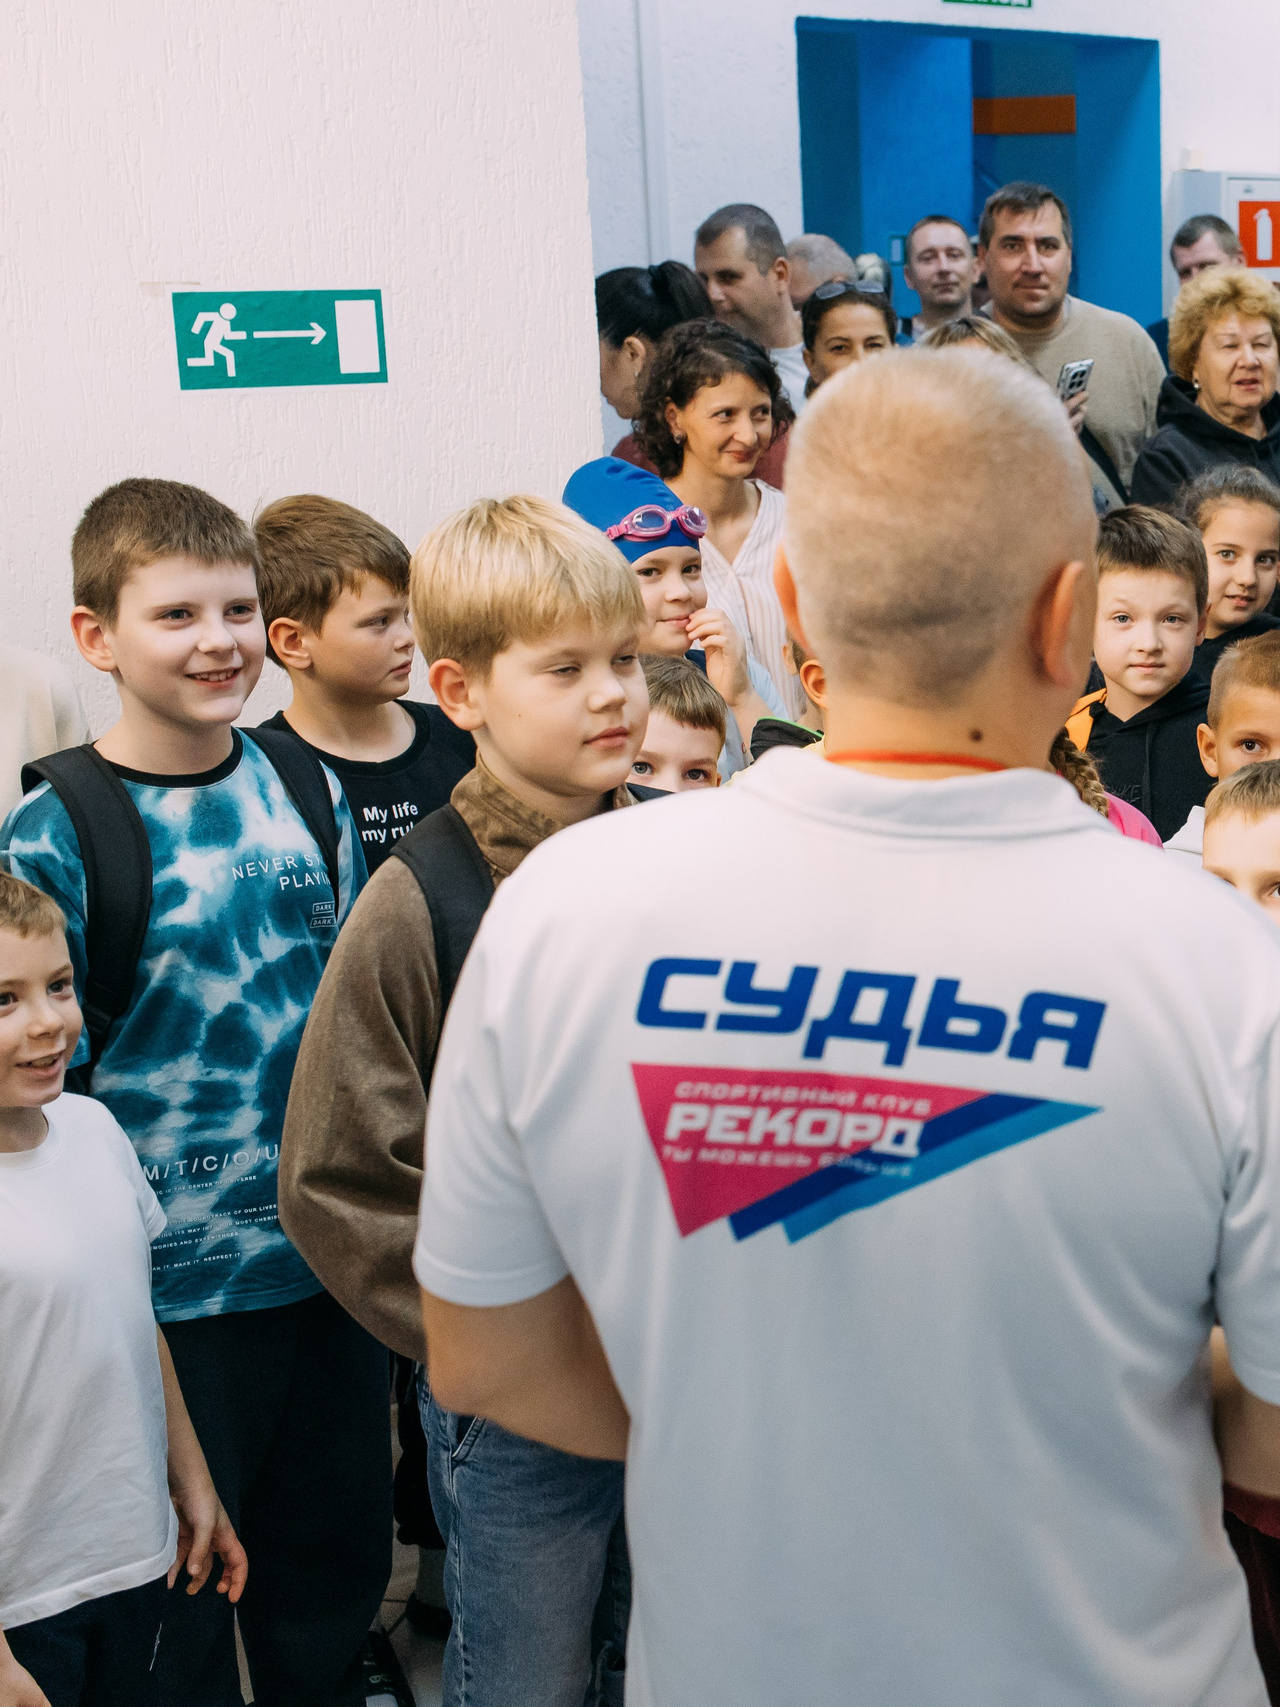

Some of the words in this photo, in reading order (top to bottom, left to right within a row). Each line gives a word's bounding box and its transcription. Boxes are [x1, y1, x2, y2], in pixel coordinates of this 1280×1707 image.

[363, 806, 388, 823] My
[391, 801, 419, 819] life
[361, 829, 387, 844] my
[391, 821, 414, 839] rul
[231, 855, 298, 881] NEVER
[303, 853, 322, 867] ST
[315, 903, 332, 912] DARK
[313, 918, 332, 926] DARK
[635, 956, 1108, 1071] СУДЬЯ
[674, 1081, 858, 1107] СПОРТИВНЫЙ
[862, 1092, 932, 1116] КЛУБ
[664, 1102, 925, 1158] РЕКОРД
[188, 1182, 213, 1190] CENTER
[235, 1218, 252, 1226] MOST
[151, 1242, 178, 1251] MORIES
[173, 1260, 191, 1268] MAKE
[203, 1252, 233, 1262] RESPECT
